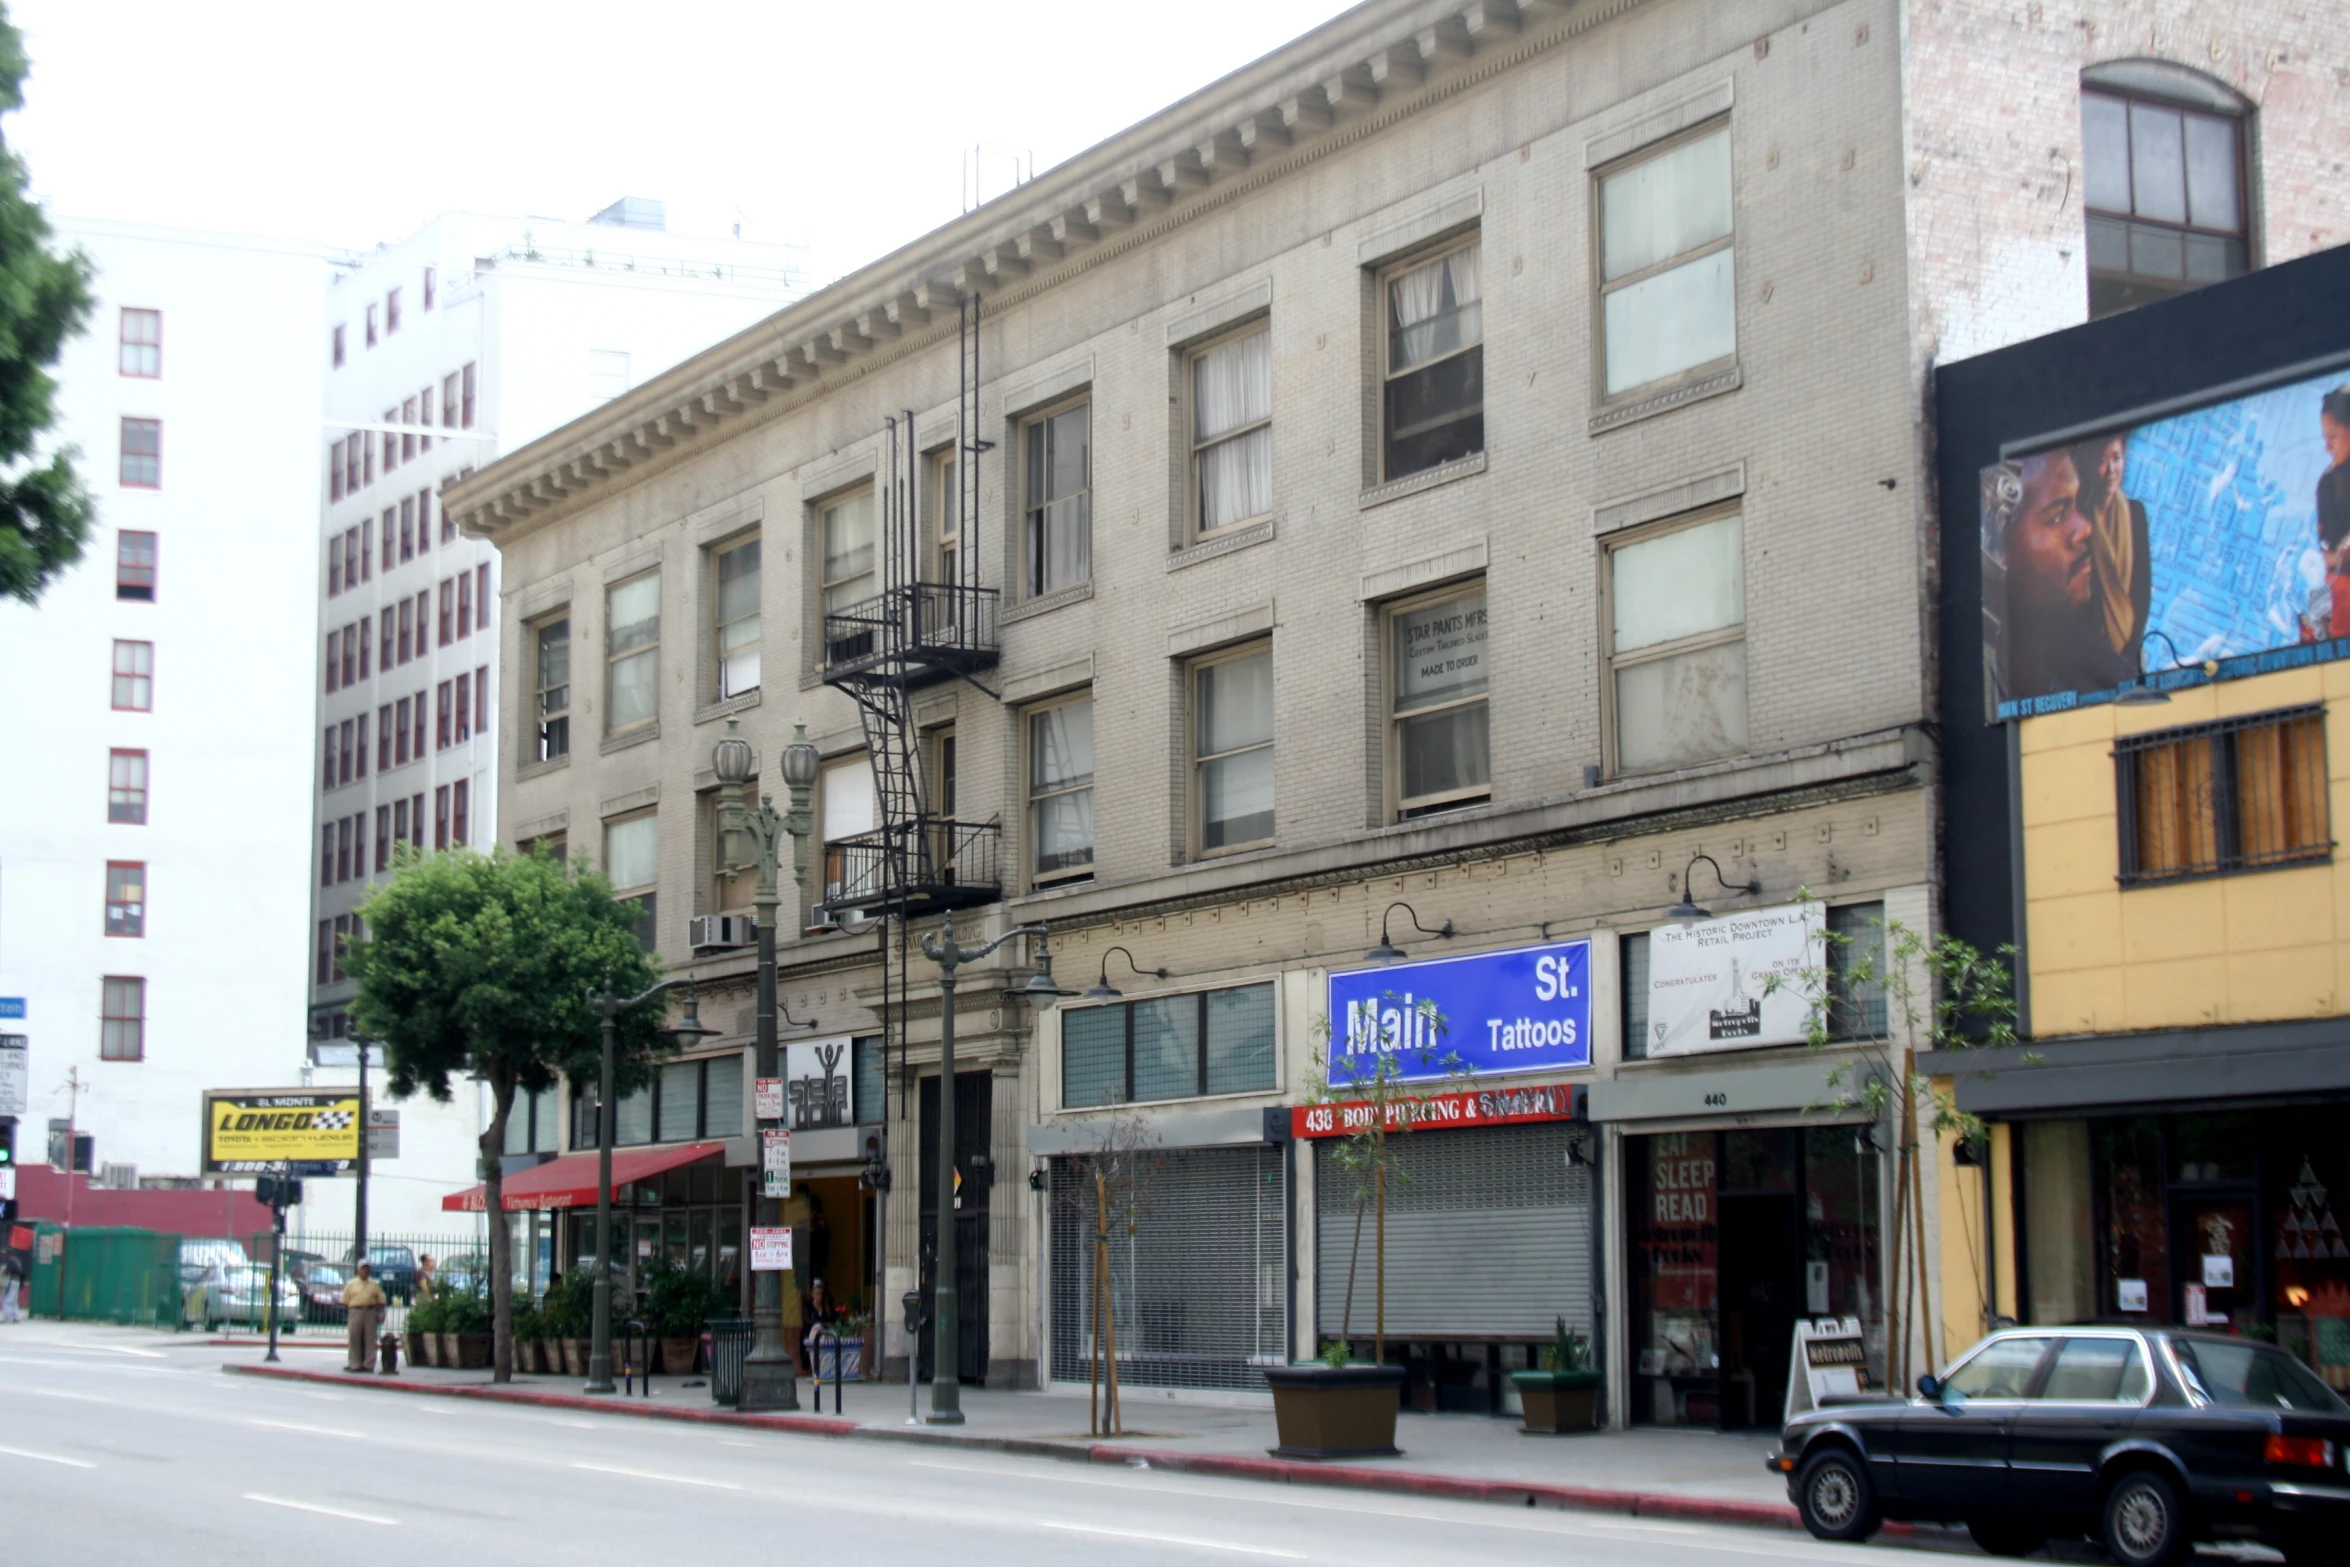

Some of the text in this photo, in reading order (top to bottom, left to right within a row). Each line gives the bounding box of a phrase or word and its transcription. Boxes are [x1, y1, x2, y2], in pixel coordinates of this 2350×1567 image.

[1407, 623, 1430, 644] STAR
[1432, 615, 1463, 637] PANTS
[1409, 646, 1435, 658] CUSTOM
[1436, 638, 1465, 651] TAILORED
[1421, 655, 1479, 678] MADE TO ORDER
[2020, 699, 2032, 716] ST
[2034, 690, 2077, 714] RECOVERY
[1666, 932, 1683, 943] THE
[1685, 924, 1727, 939] HISTORIC
[1730, 917, 1785, 932] DOWNTOWN
[1697, 929, 1773, 948] RETAIL PROJECT
[1772, 958, 1800, 968] ON ITS
[1535, 955, 1579, 1002] St.
[1654, 974, 1718, 989] CONGRATULATES
[1751, 970, 1781, 981] GRAND
[1346, 992, 1438, 1056] Main
[1486, 1018, 1577, 1052] Tattoos
[757, 1084, 768, 1092] NO
[258, 1097, 315, 1107] EL MONTE
[1704, 1093, 1727, 1106] 440
[219, 1112, 313, 1131] LONGO
[1306, 1108, 1333, 1132] 438
[1465, 1098, 1476, 1118] &
[1656, 1160, 1715, 1190] SLEEP
[1656, 1193, 1707, 1222] READ
[752, 1240, 789, 1250] NO STOPPING
[1810, 1344, 1864, 1363] Metropolis
